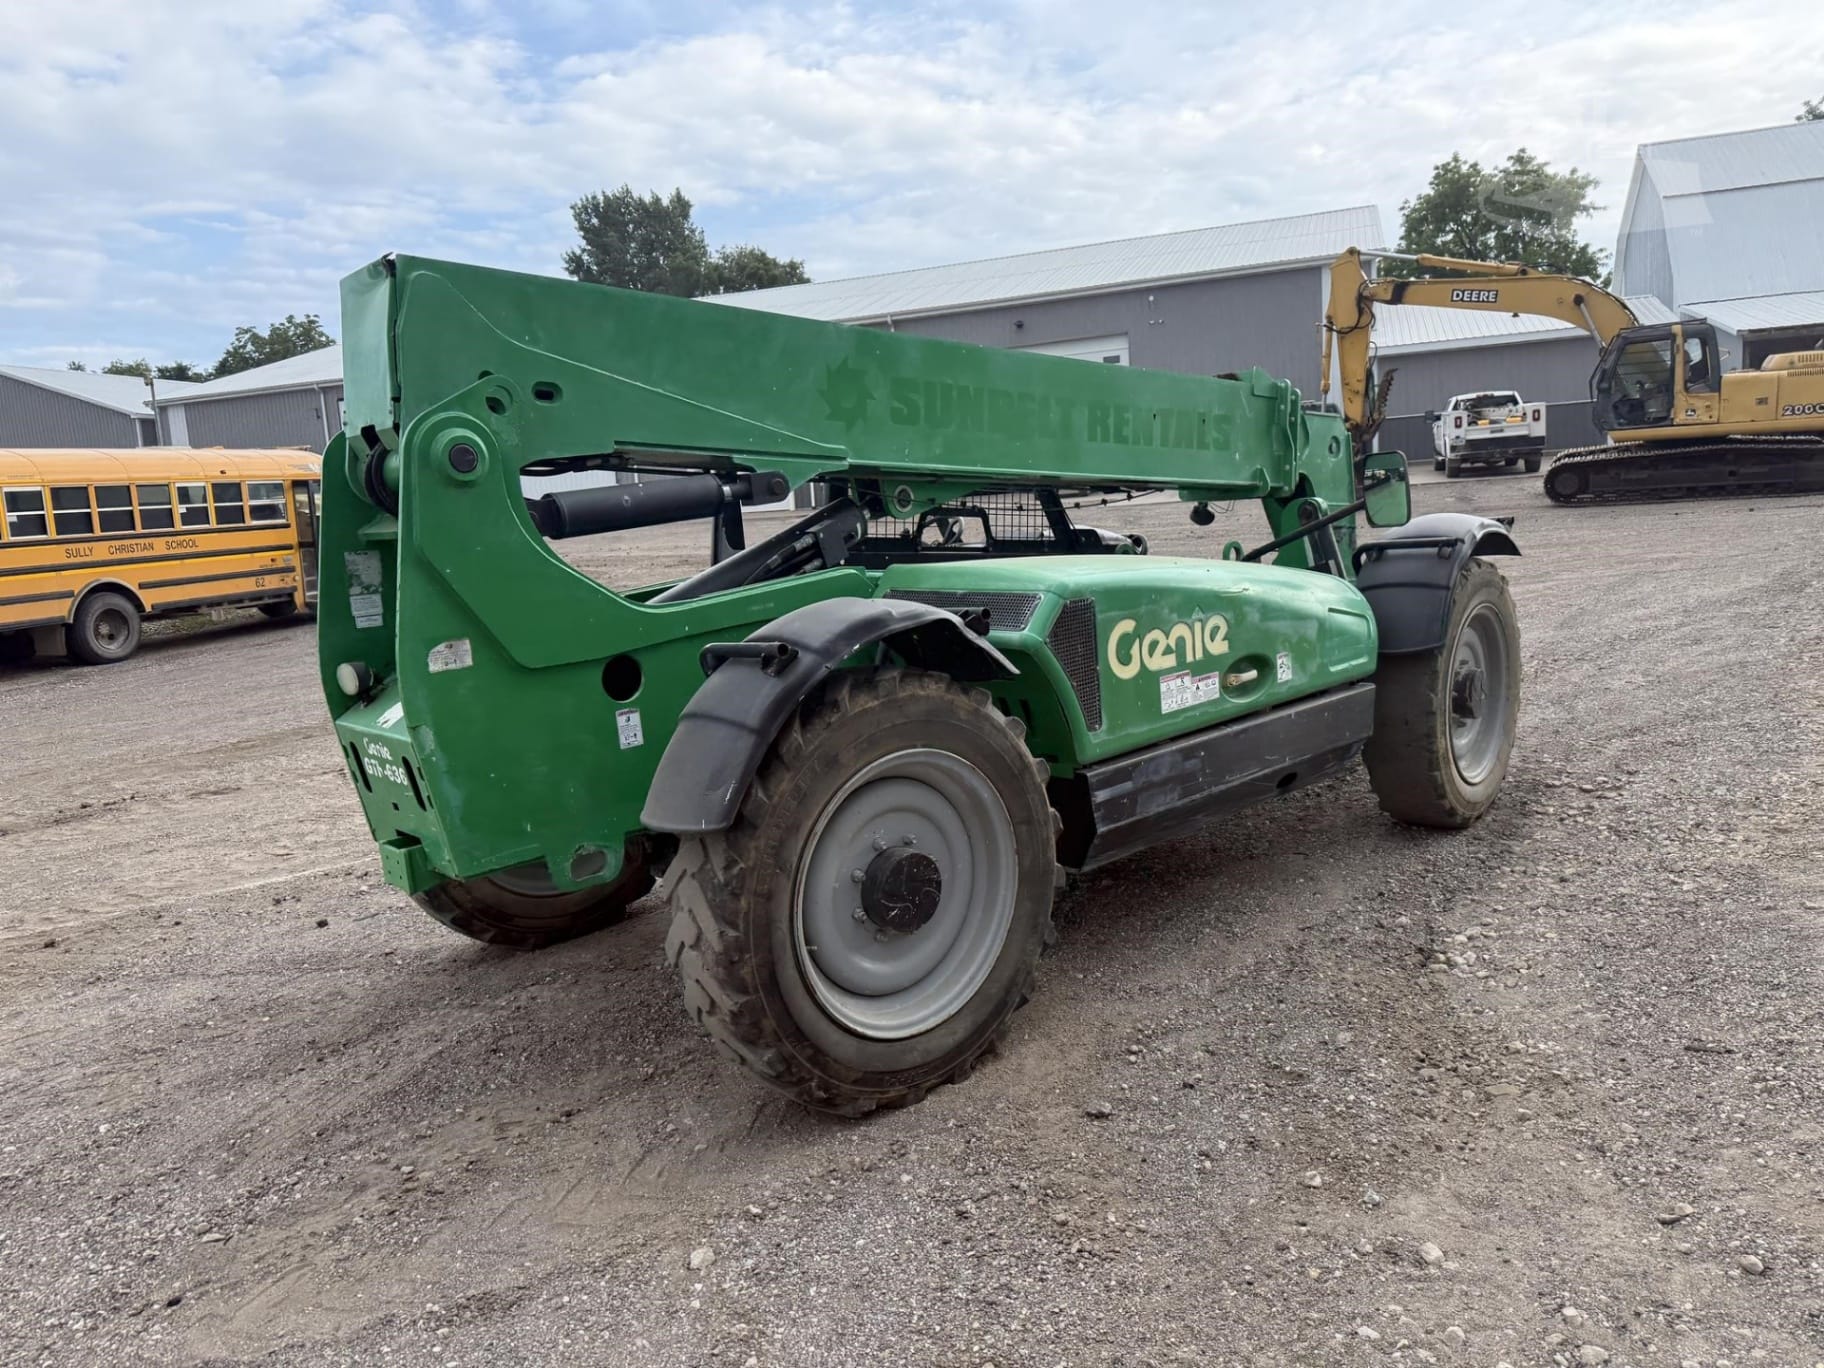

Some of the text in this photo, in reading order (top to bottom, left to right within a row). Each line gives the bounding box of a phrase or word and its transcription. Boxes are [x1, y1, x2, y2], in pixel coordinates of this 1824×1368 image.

[1452, 290, 1497, 302] DEERE
[1783, 403, 1824, 415] 200C
[1086, 400, 1233, 451] RENTALS
[65, 538, 199, 559] SULLY CHRISTIAN SCHOOL
[255, 577, 265, 588] 62
[1107, 614, 1230, 680] Genie
